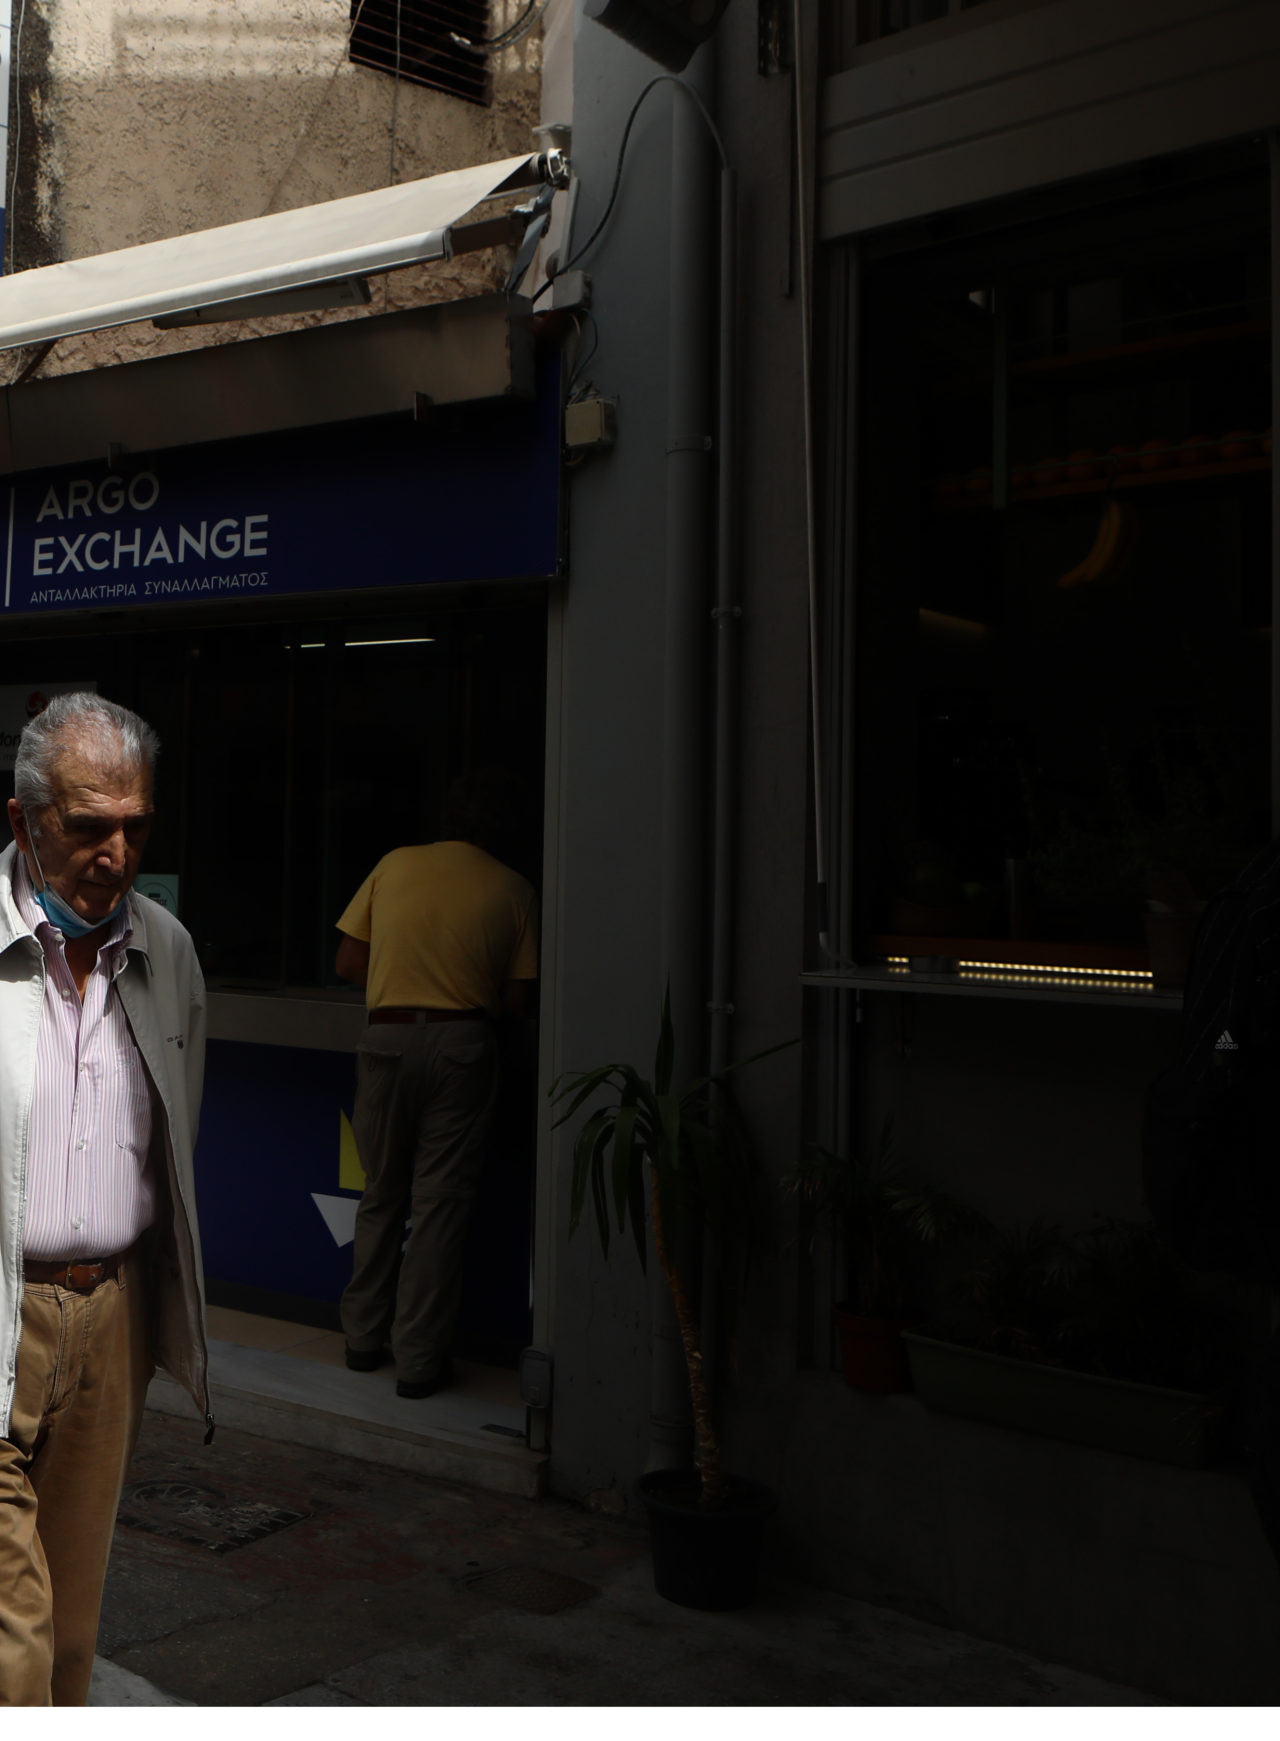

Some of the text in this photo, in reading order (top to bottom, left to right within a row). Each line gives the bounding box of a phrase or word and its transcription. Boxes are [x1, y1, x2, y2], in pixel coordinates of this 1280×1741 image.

[35, 471, 161, 524] ARGO
[32, 514, 269, 577] EXCHANGE
[29, 572, 270, 604] ΑΝΤΑΛΛΑΚΤΗΡΙΑ ΣΥΝΑΛΛΑΓΜΑΤΟΣ
[1215, 1042, 1239, 1050] adidas
